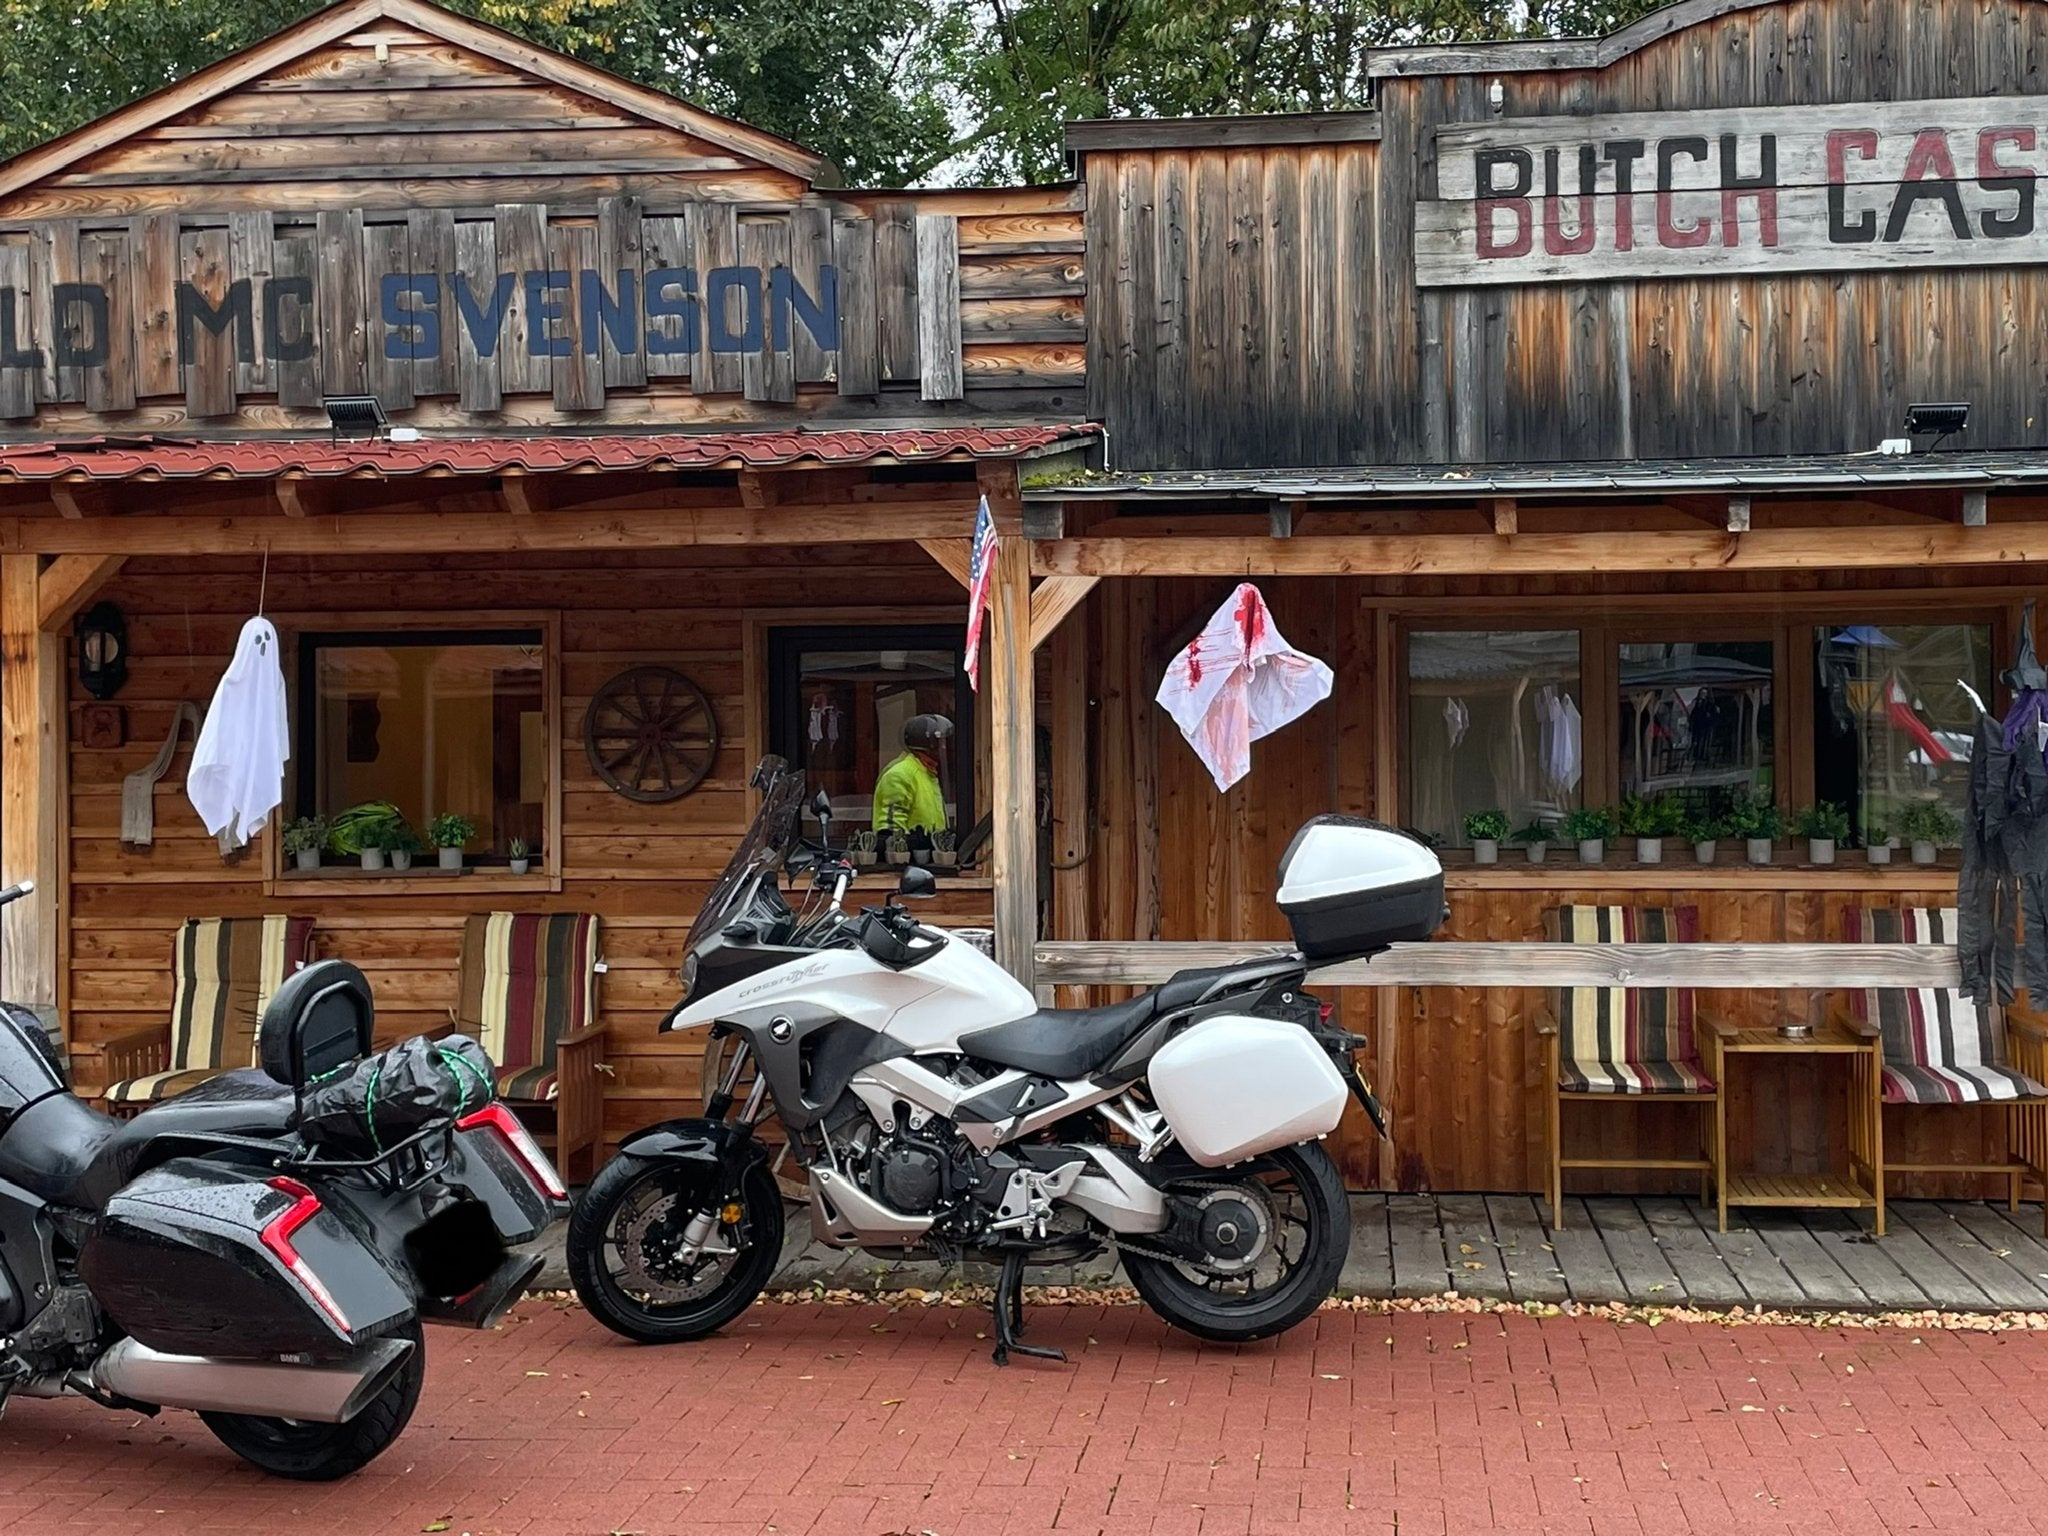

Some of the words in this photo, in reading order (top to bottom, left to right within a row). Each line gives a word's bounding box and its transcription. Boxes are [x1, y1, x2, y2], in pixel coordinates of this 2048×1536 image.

[1474, 133, 1778, 260] BUTCH
[1825, 126, 2037, 244] CAS
[0, 283, 109, 368] LD
[174, 275, 314, 366] MC
[381, 264, 840, 360] SVENSON
[279, 1353, 300, 1363] BMW
